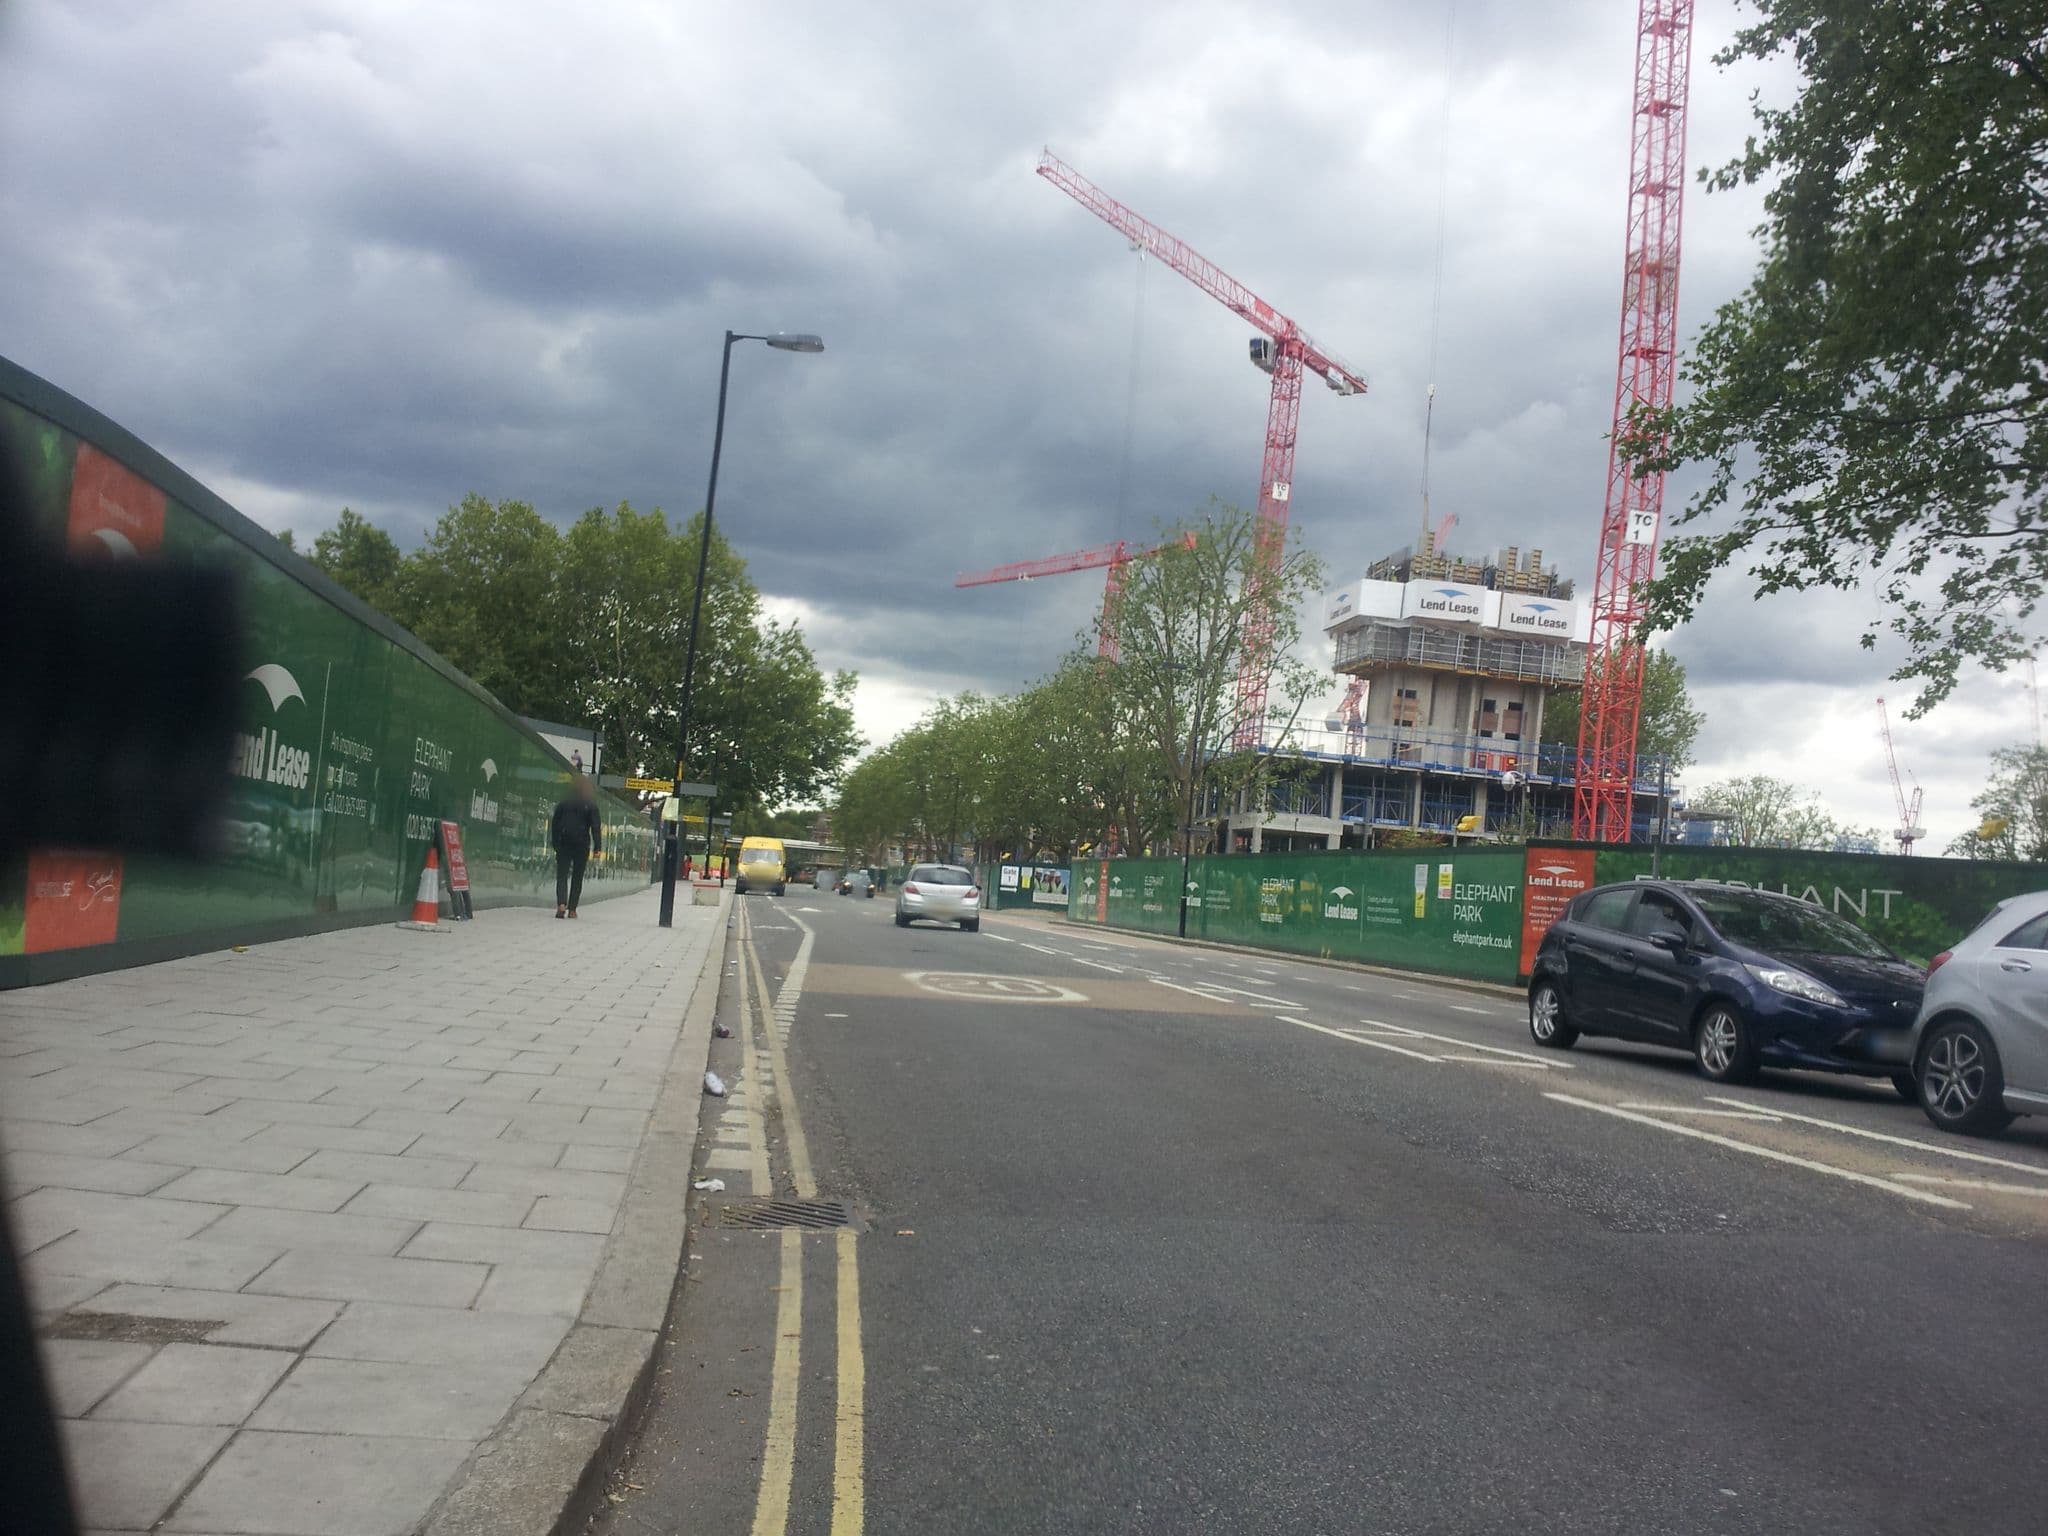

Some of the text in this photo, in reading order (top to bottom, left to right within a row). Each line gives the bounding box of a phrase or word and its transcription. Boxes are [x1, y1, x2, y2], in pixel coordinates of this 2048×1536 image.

[1635, 513, 1652, 526] TC
[1633, 530, 1639, 540] 1
[1420, 598, 1479, 615] Lend Lease
[1510, 612, 1567, 629] Lend Lease
[231, 726, 310, 789] end Lease
[415, 732, 453, 772] ELEPHANT
[410, 771, 432, 800] PARK
[1529, 875, 1585, 888] Lend Lease
[1454, 883, 1516, 904] ELEPHANT
[1325, 902, 1339, 918] Lend
[1340, 904, 1358, 920] Lease
[1453, 904, 1483, 923] PARK
[1452, 930, 1513, 950] elephantpark.co.uk
